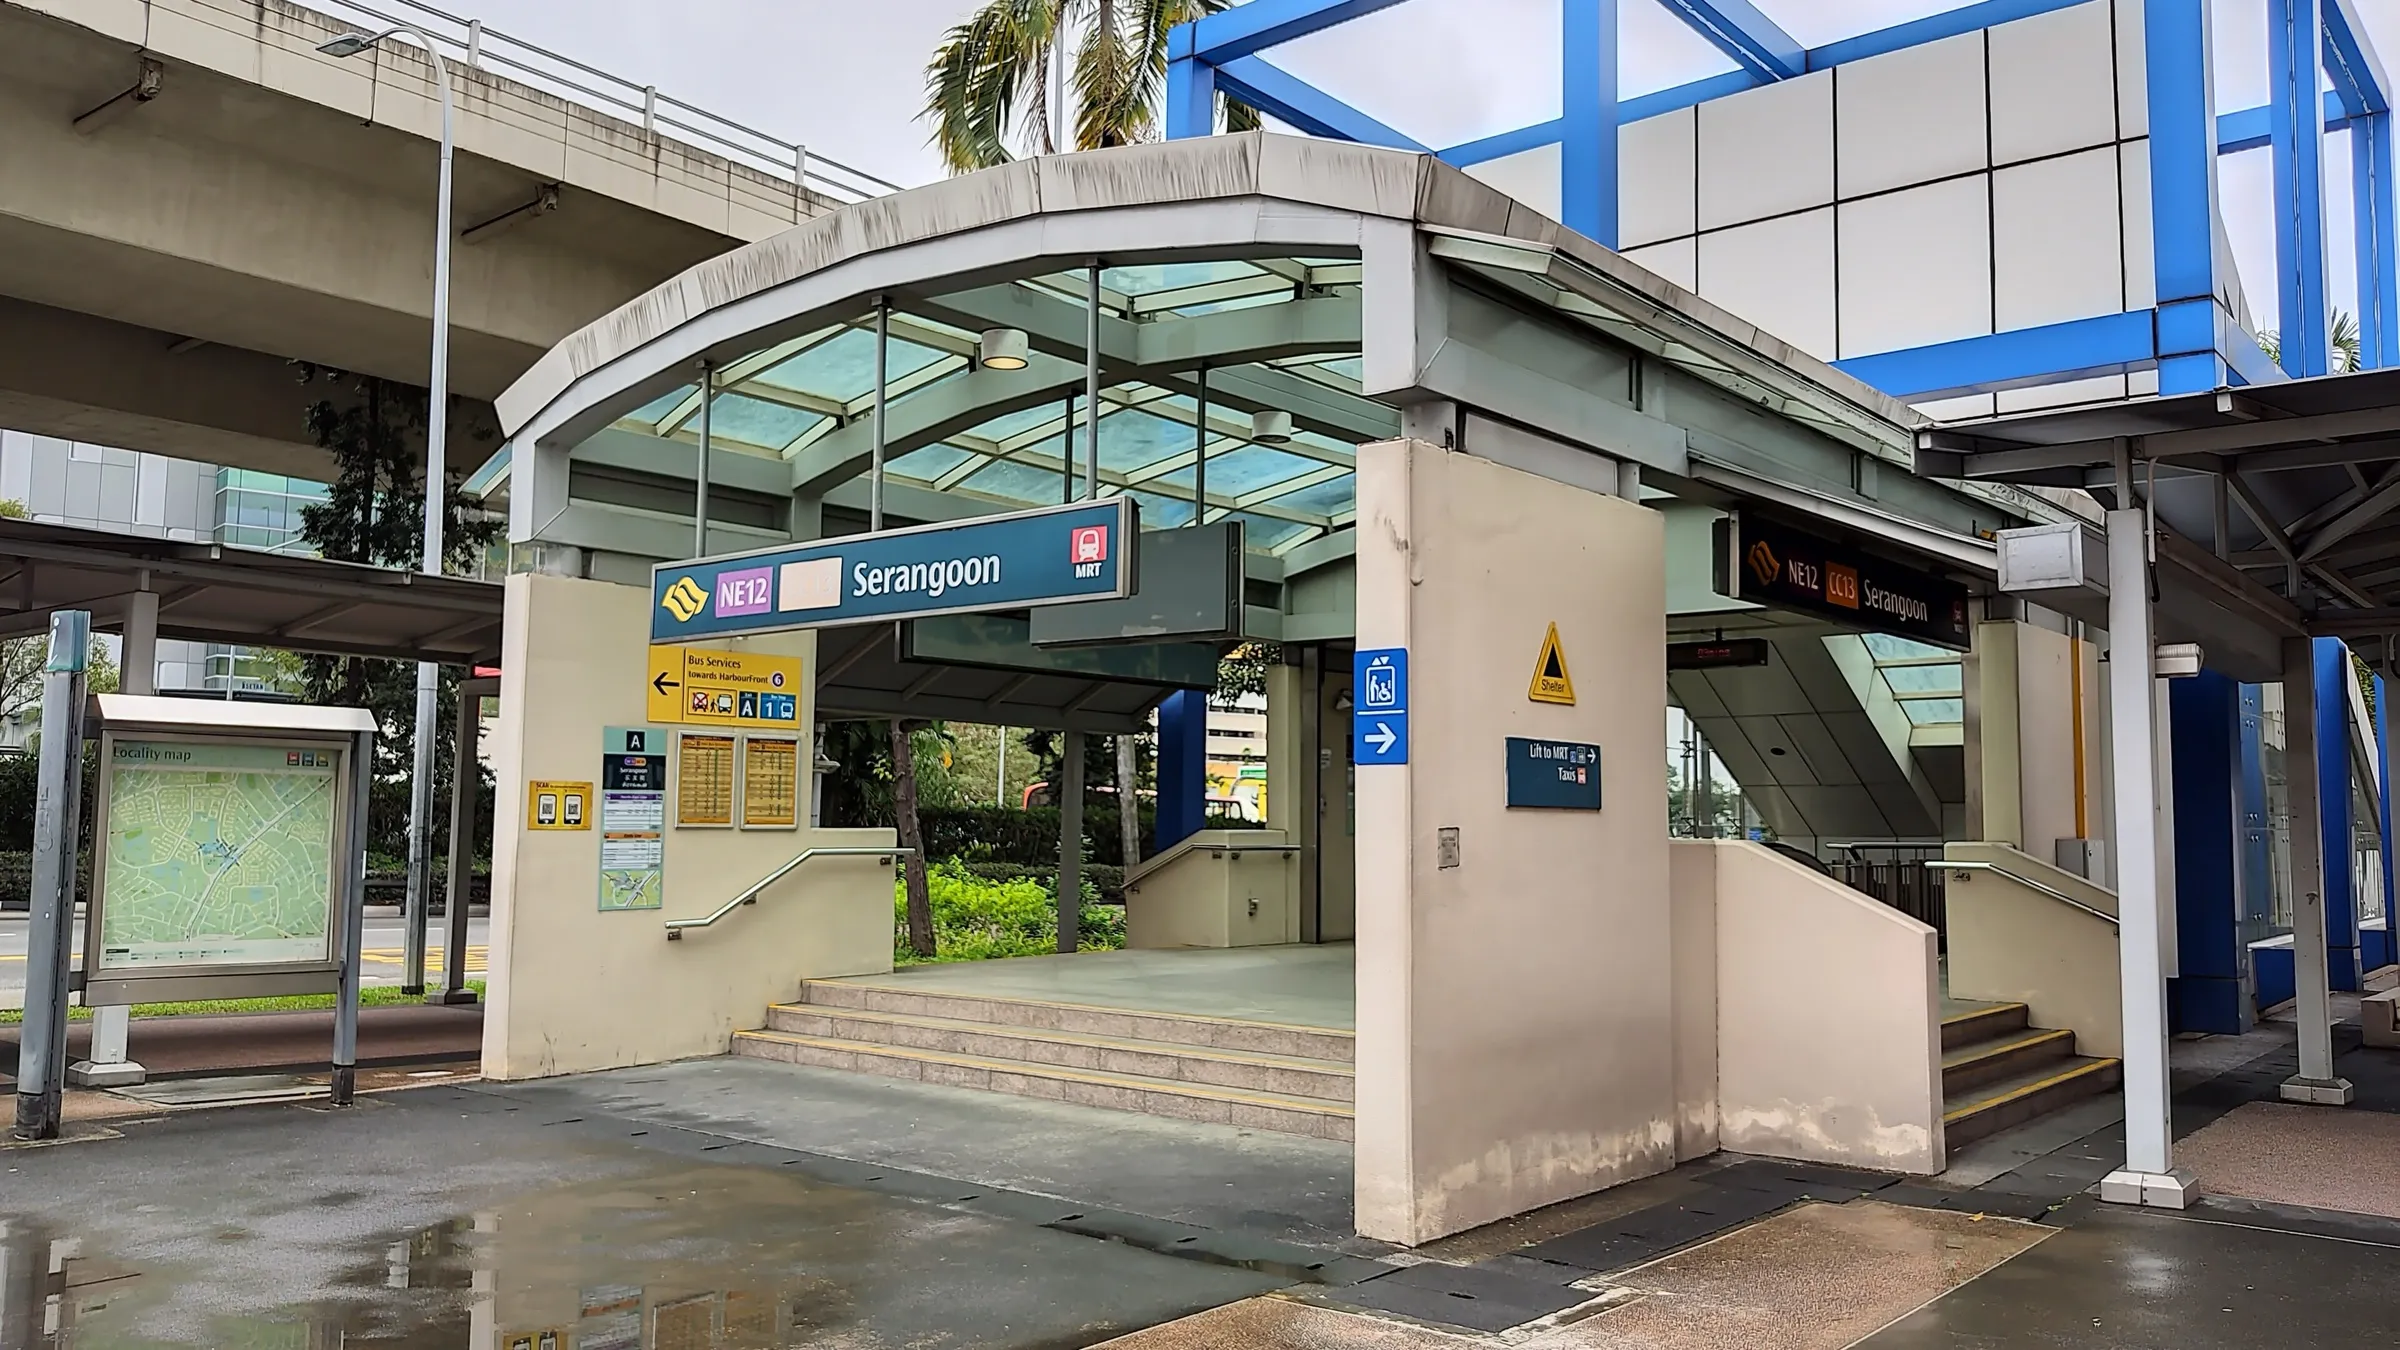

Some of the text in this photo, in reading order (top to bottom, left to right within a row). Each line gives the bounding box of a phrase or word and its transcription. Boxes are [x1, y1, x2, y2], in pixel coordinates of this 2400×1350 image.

[1073, 562, 1102, 579] MRT
[719, 576, 767, 608] NE12
[852, 553, 1000, 598] Serangoon
[1788, 559, 1928, 622] NE12 CC13 Serangoon
[688, 654, 741, 669] Bus Services
[688, 670, 782, 685] towards HarbourFront 6
[1541, 678, 1565, 694] Shelter
[741, 699, 753, 716] A
[765, 701, 773, 717] 1
[630, 734, 641, 749] A
[113, 746, 191, 762] Locality map
[1529, 743, 1569, 761] Lift to MRT
[1558, 767, 1576, 782] Taxis
